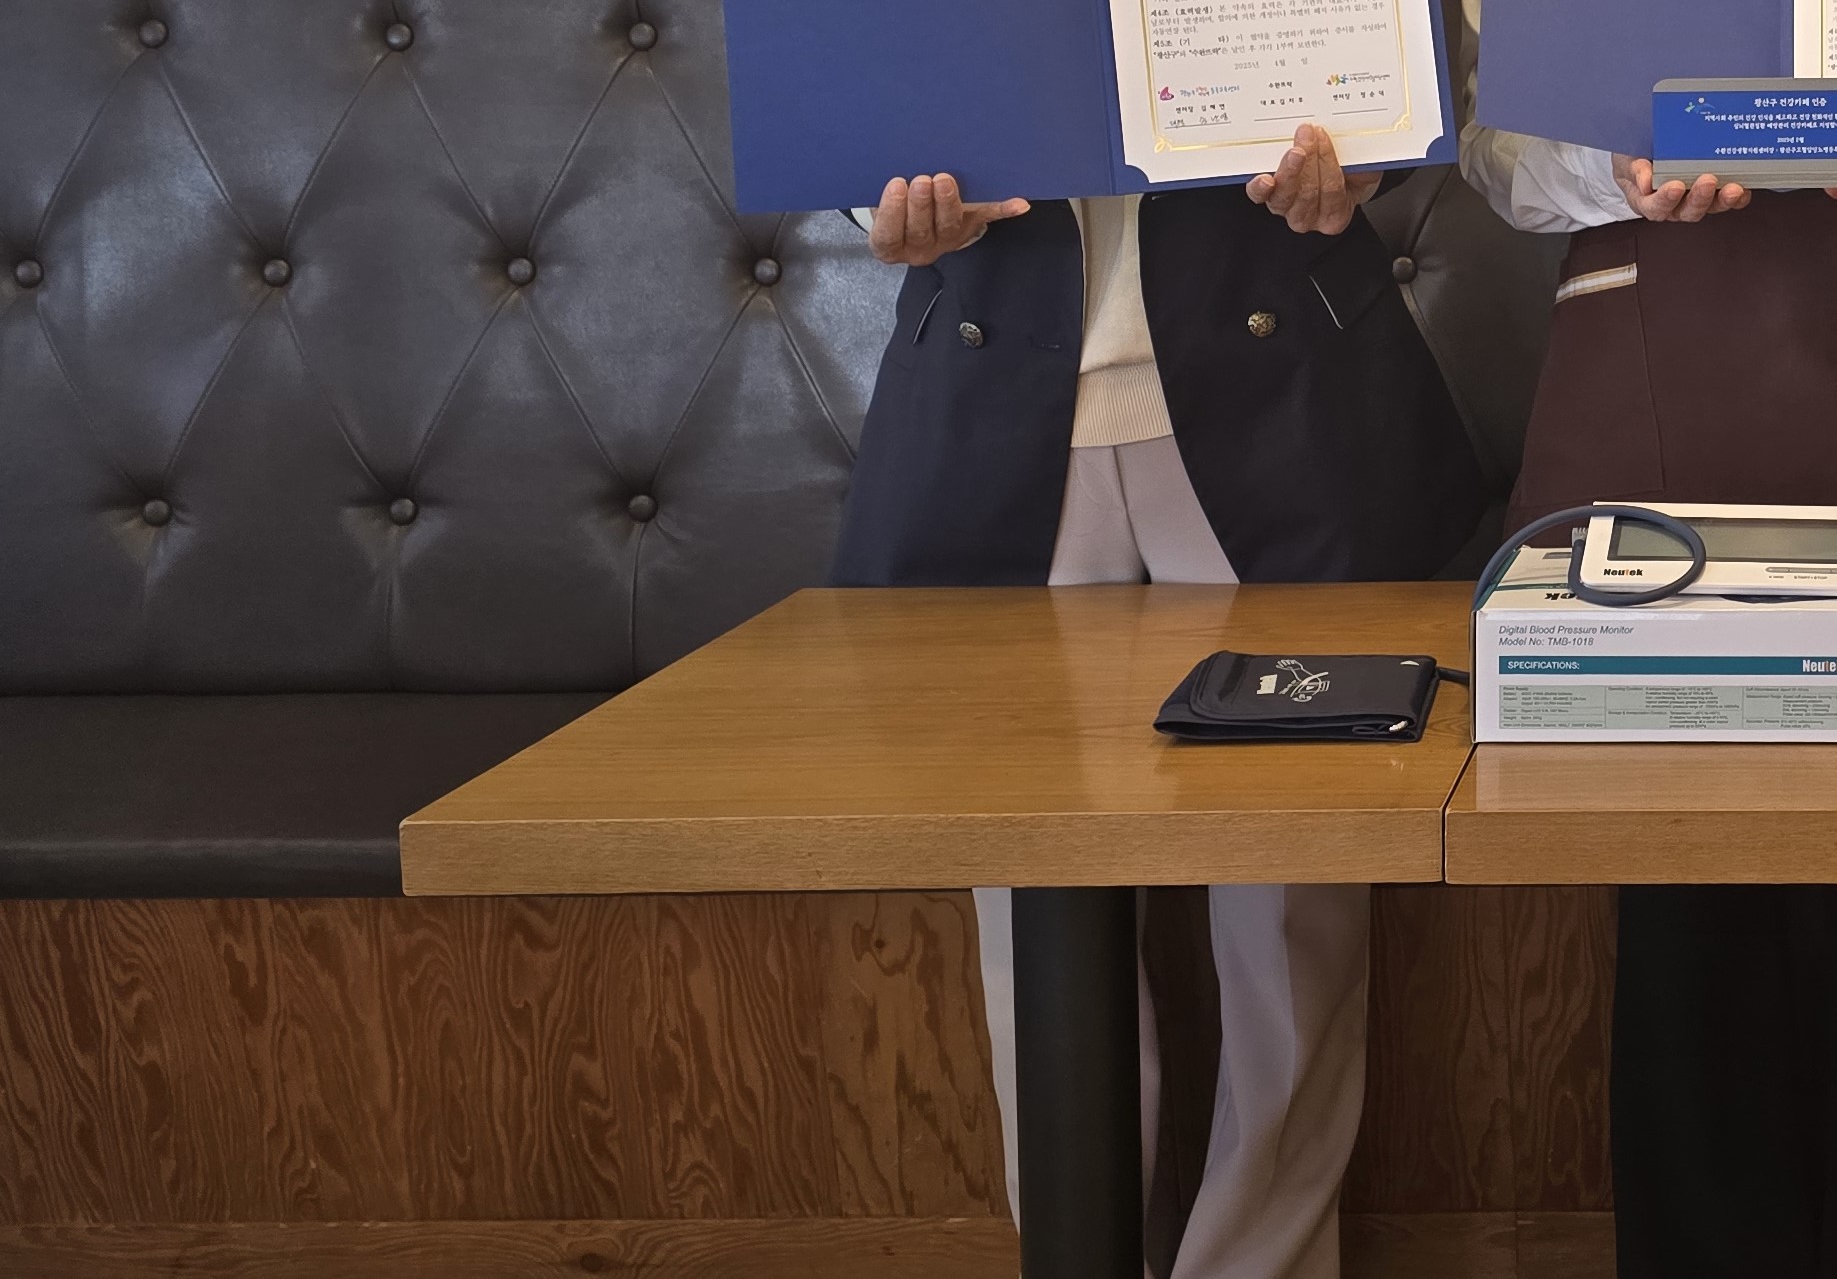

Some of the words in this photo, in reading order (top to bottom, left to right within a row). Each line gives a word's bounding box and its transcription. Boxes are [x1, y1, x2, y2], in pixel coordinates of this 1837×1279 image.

[1754, 98, 1777, 108] 광산구
[1780, 97, 1809, 107] 건강카페
[1603, 568, 1643, 576] Neutek
[1499, 626, 1527, 636] Digital
[1529, 626, 1555, 634] Blood
[1558, 626, 1597, 634] Pressure
[1600, 626, 1634, 634] Monitor
[1499, 638, 1526, 646] Model
[1529, 638, 1544, 646] No:
[1507, 660, 1580, 670] SPECIFICATIONS:
